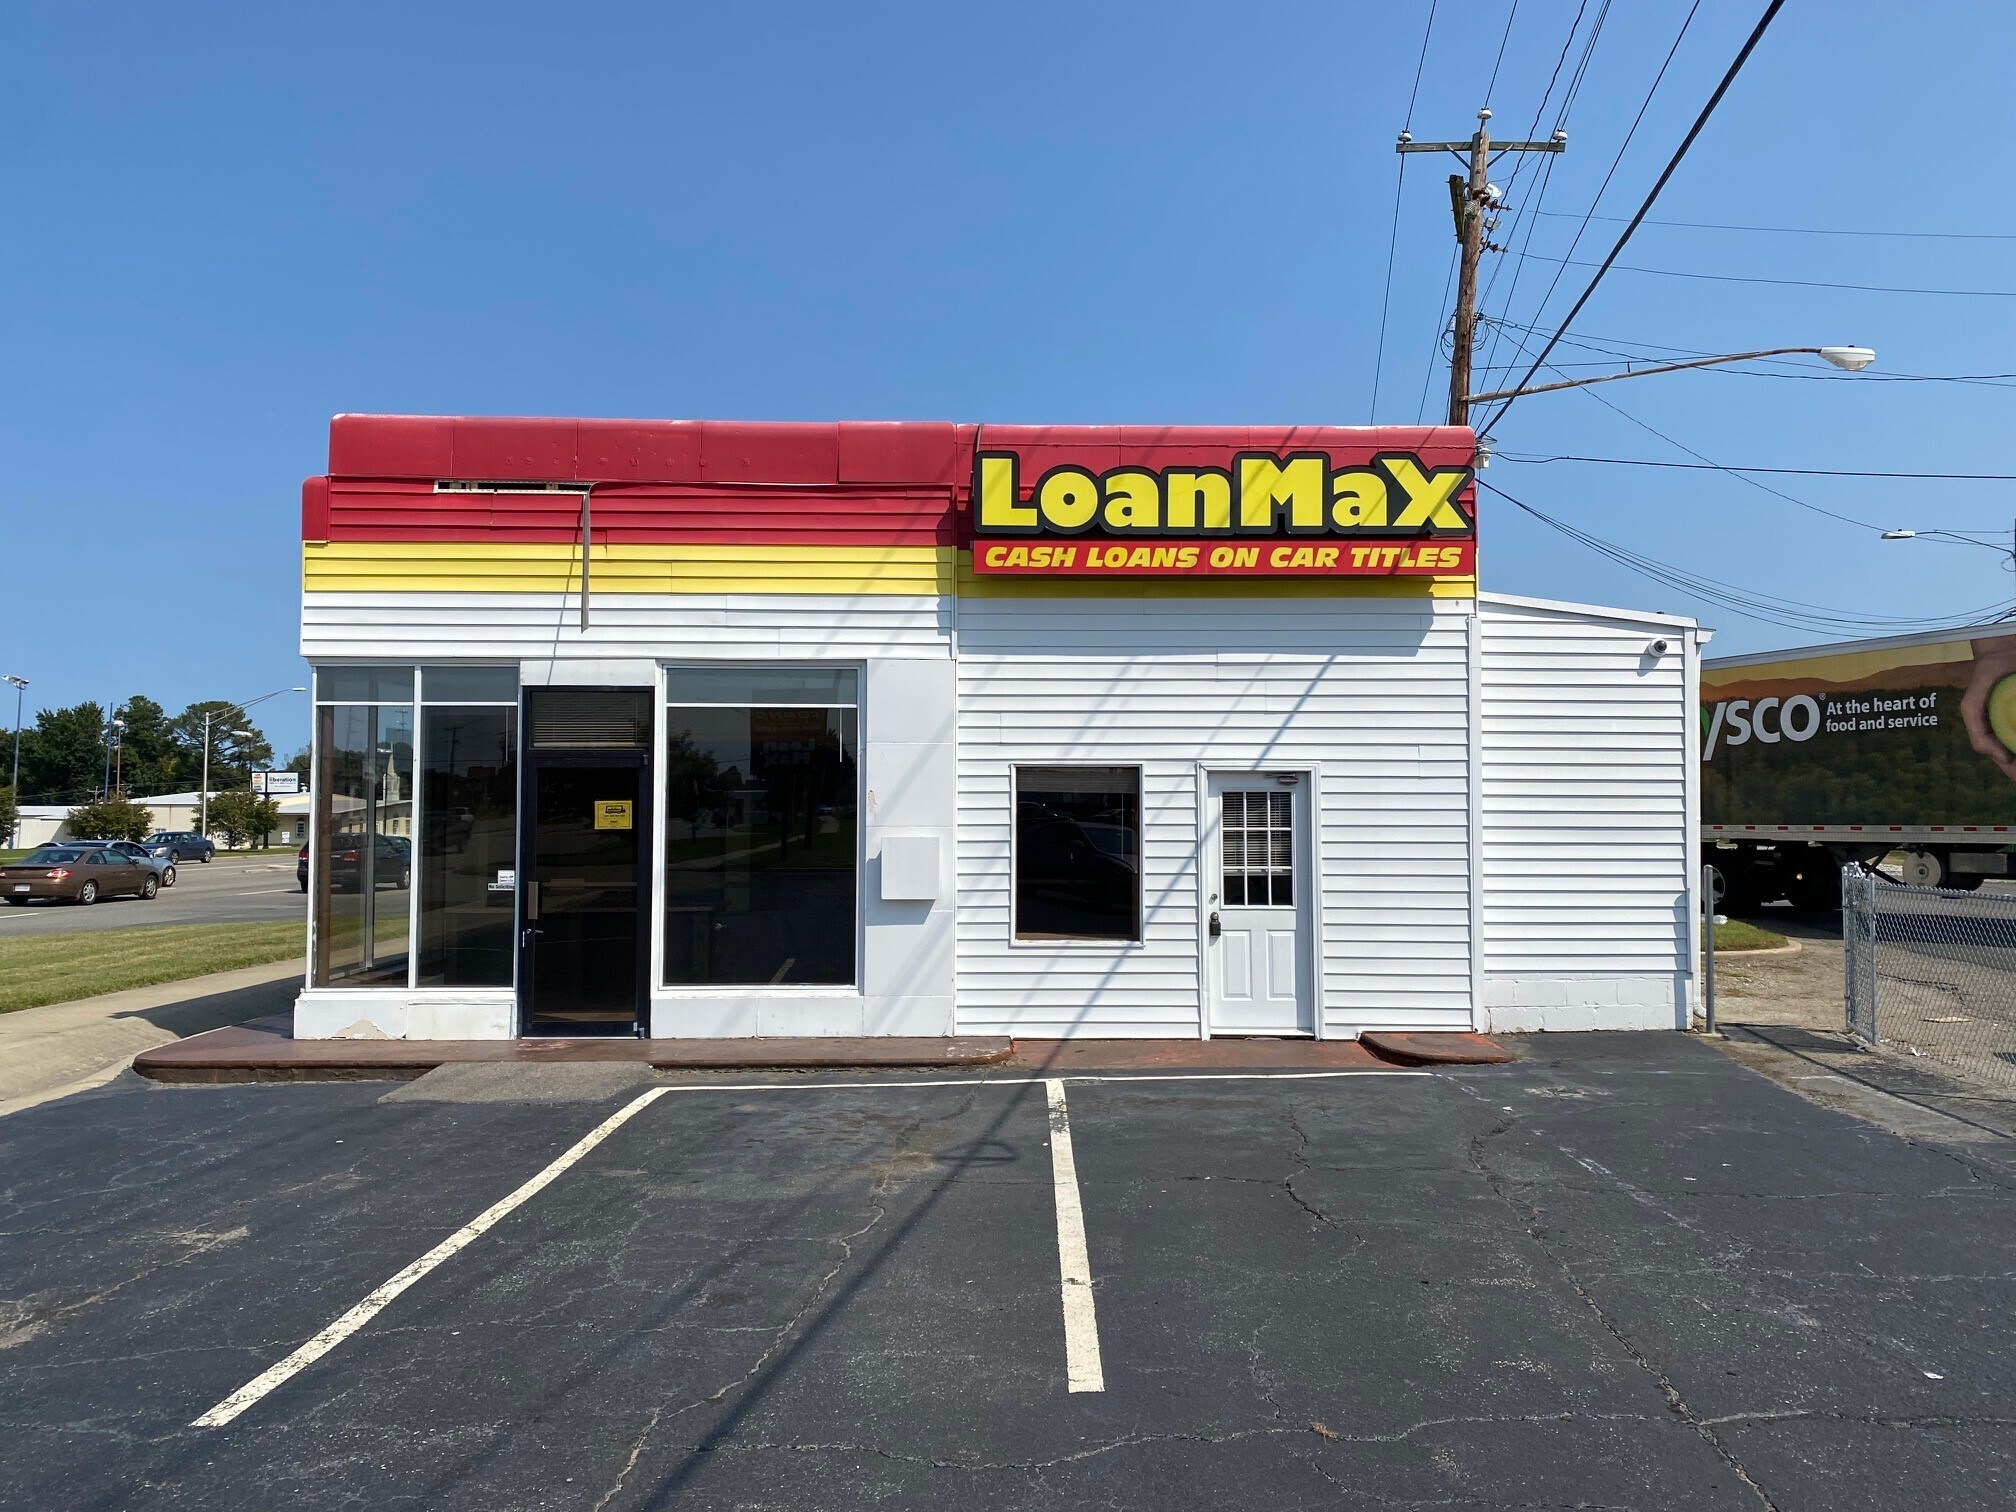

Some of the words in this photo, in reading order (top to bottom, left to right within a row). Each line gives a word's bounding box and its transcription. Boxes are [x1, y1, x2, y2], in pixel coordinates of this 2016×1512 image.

[980, 457, 1469, 530] LoanMax
[985, 546, 1077, 568] CASH
[1085, 546, 1200, 568] LOANS
[1209, 546, 1255, 568] ON
[1270, 546, 1339, 568] CAR
[1350, 546, 1463, 568] TITLES
[1826, 701, 1843, 716] At
[1845, 699, 1870, 714] the
[1873, 696, 1916, 712] heart
[1919, 692, 1938, 709] of
[1825, 717, 1857, 733] food
[1858, 715, 1885, 731] and
[1887, 712, 1939, 729] service
